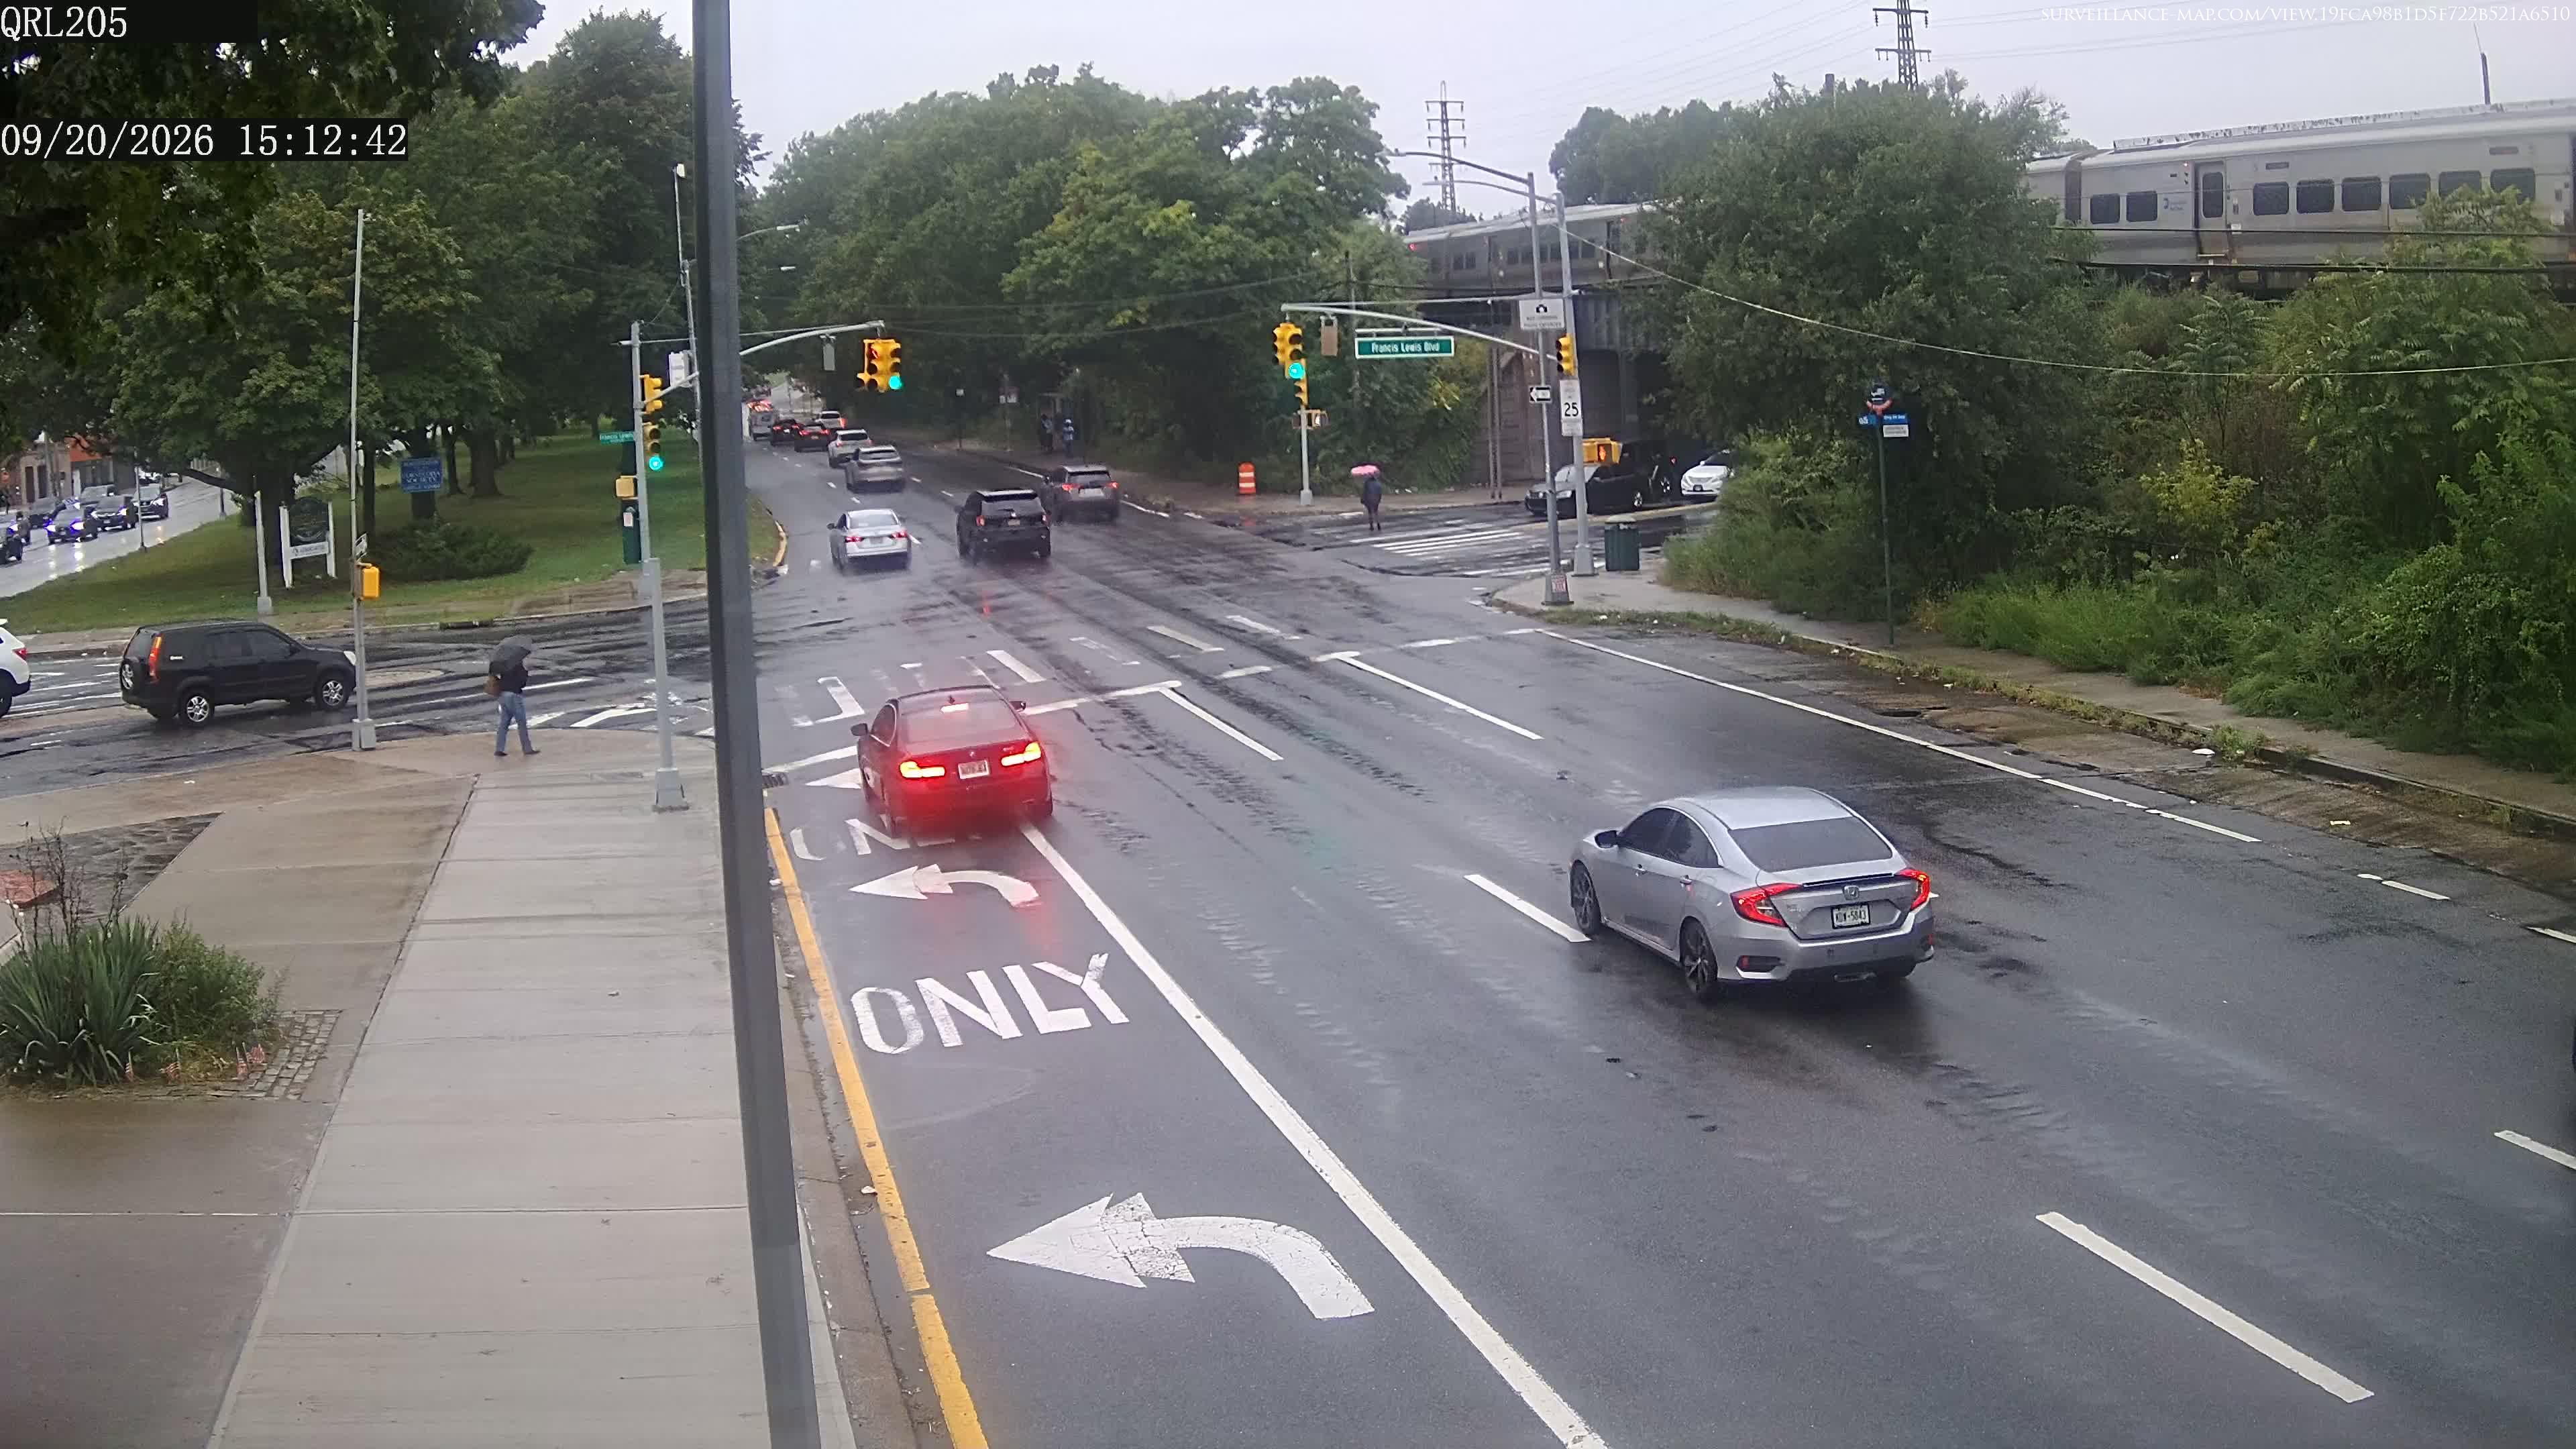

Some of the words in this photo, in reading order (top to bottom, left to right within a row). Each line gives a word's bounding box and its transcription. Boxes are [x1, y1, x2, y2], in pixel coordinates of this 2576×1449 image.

[1371, 342, 1399, 353] Francis
[1401, 342, 1422, 352] Lewis
[1424, 341, 1440, 352] Blvd
[1564, 402, 1578, 417] 25
[850, 953, 1130, 1055] ONLY
